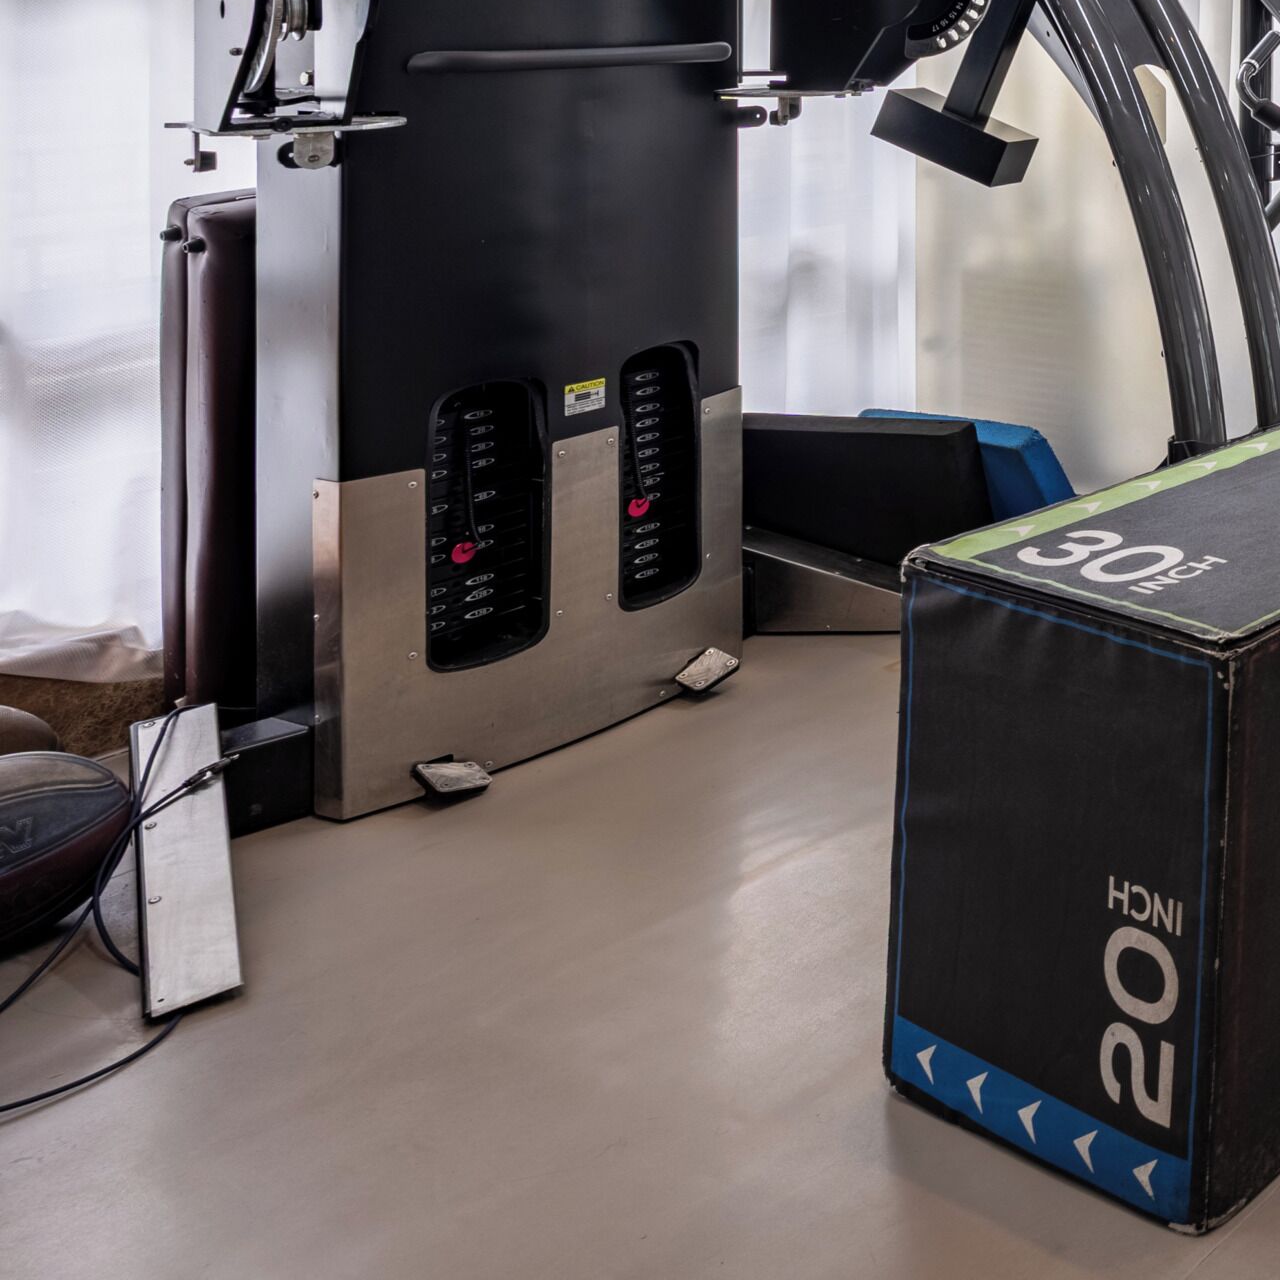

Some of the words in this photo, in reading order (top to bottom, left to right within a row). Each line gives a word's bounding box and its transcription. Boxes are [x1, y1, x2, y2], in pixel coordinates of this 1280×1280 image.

[949, 11, 957, 19] 15
[575, 380, 605, 390] CAUTION
[1016, 529, 1185, 583] 30
[1128, 554, 1229, 595] INCH
[1107, 875, 1183, 937] INCH
[1099, 925, 1180, 1130] 20
